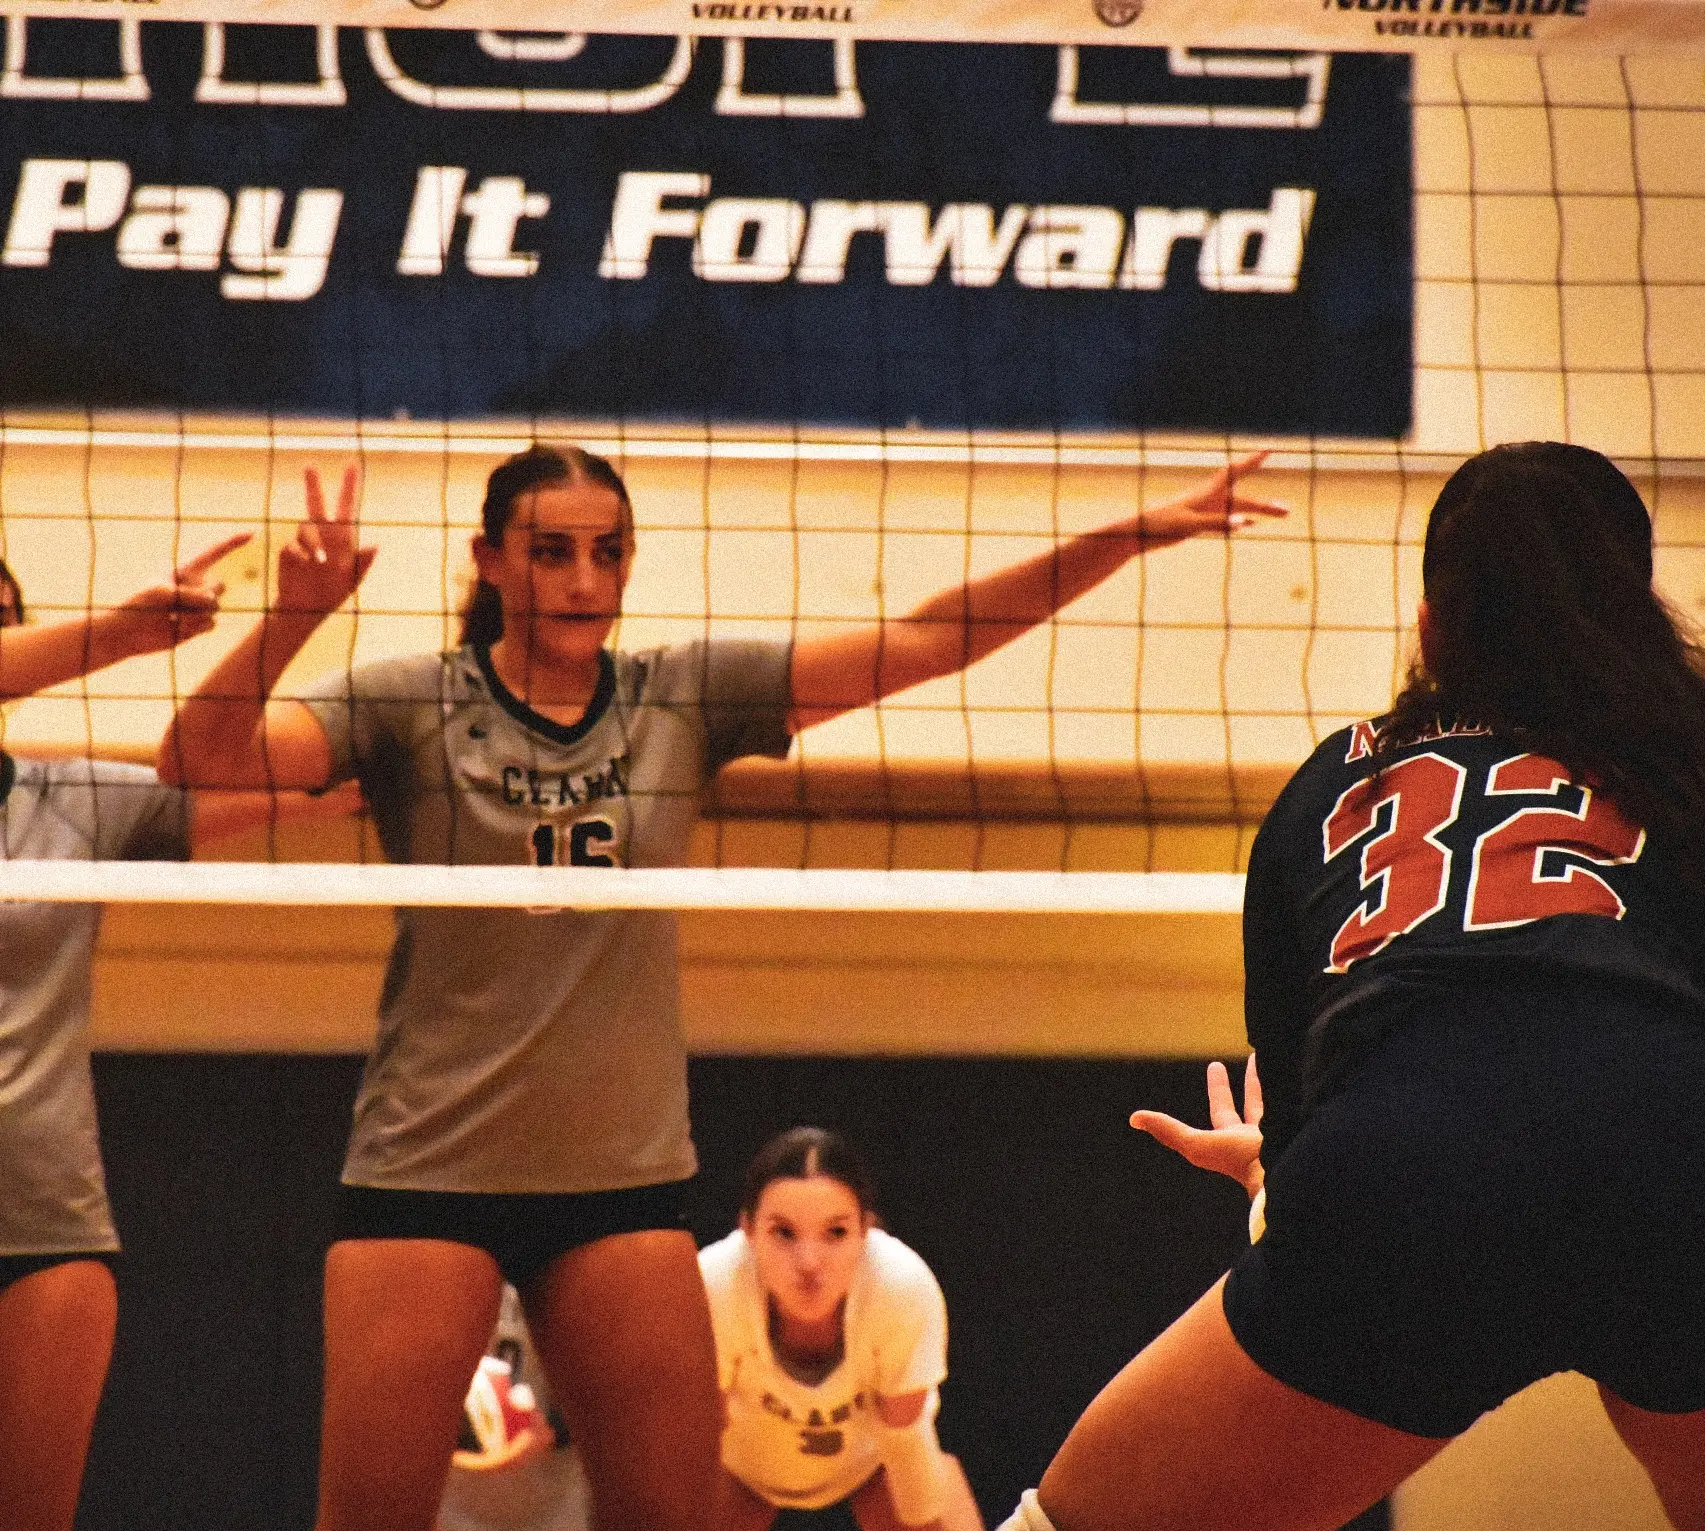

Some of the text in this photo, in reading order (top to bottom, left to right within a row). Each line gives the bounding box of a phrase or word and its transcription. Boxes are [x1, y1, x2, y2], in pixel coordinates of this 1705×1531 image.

[690, 3, 854, 22] VOLLEYBALL
[1374, 20, 1535, 39] VOLLEYBALL
[2, 158, 1317, 300] Pay It Forward
[1323, 752, 1647, 974] 32
